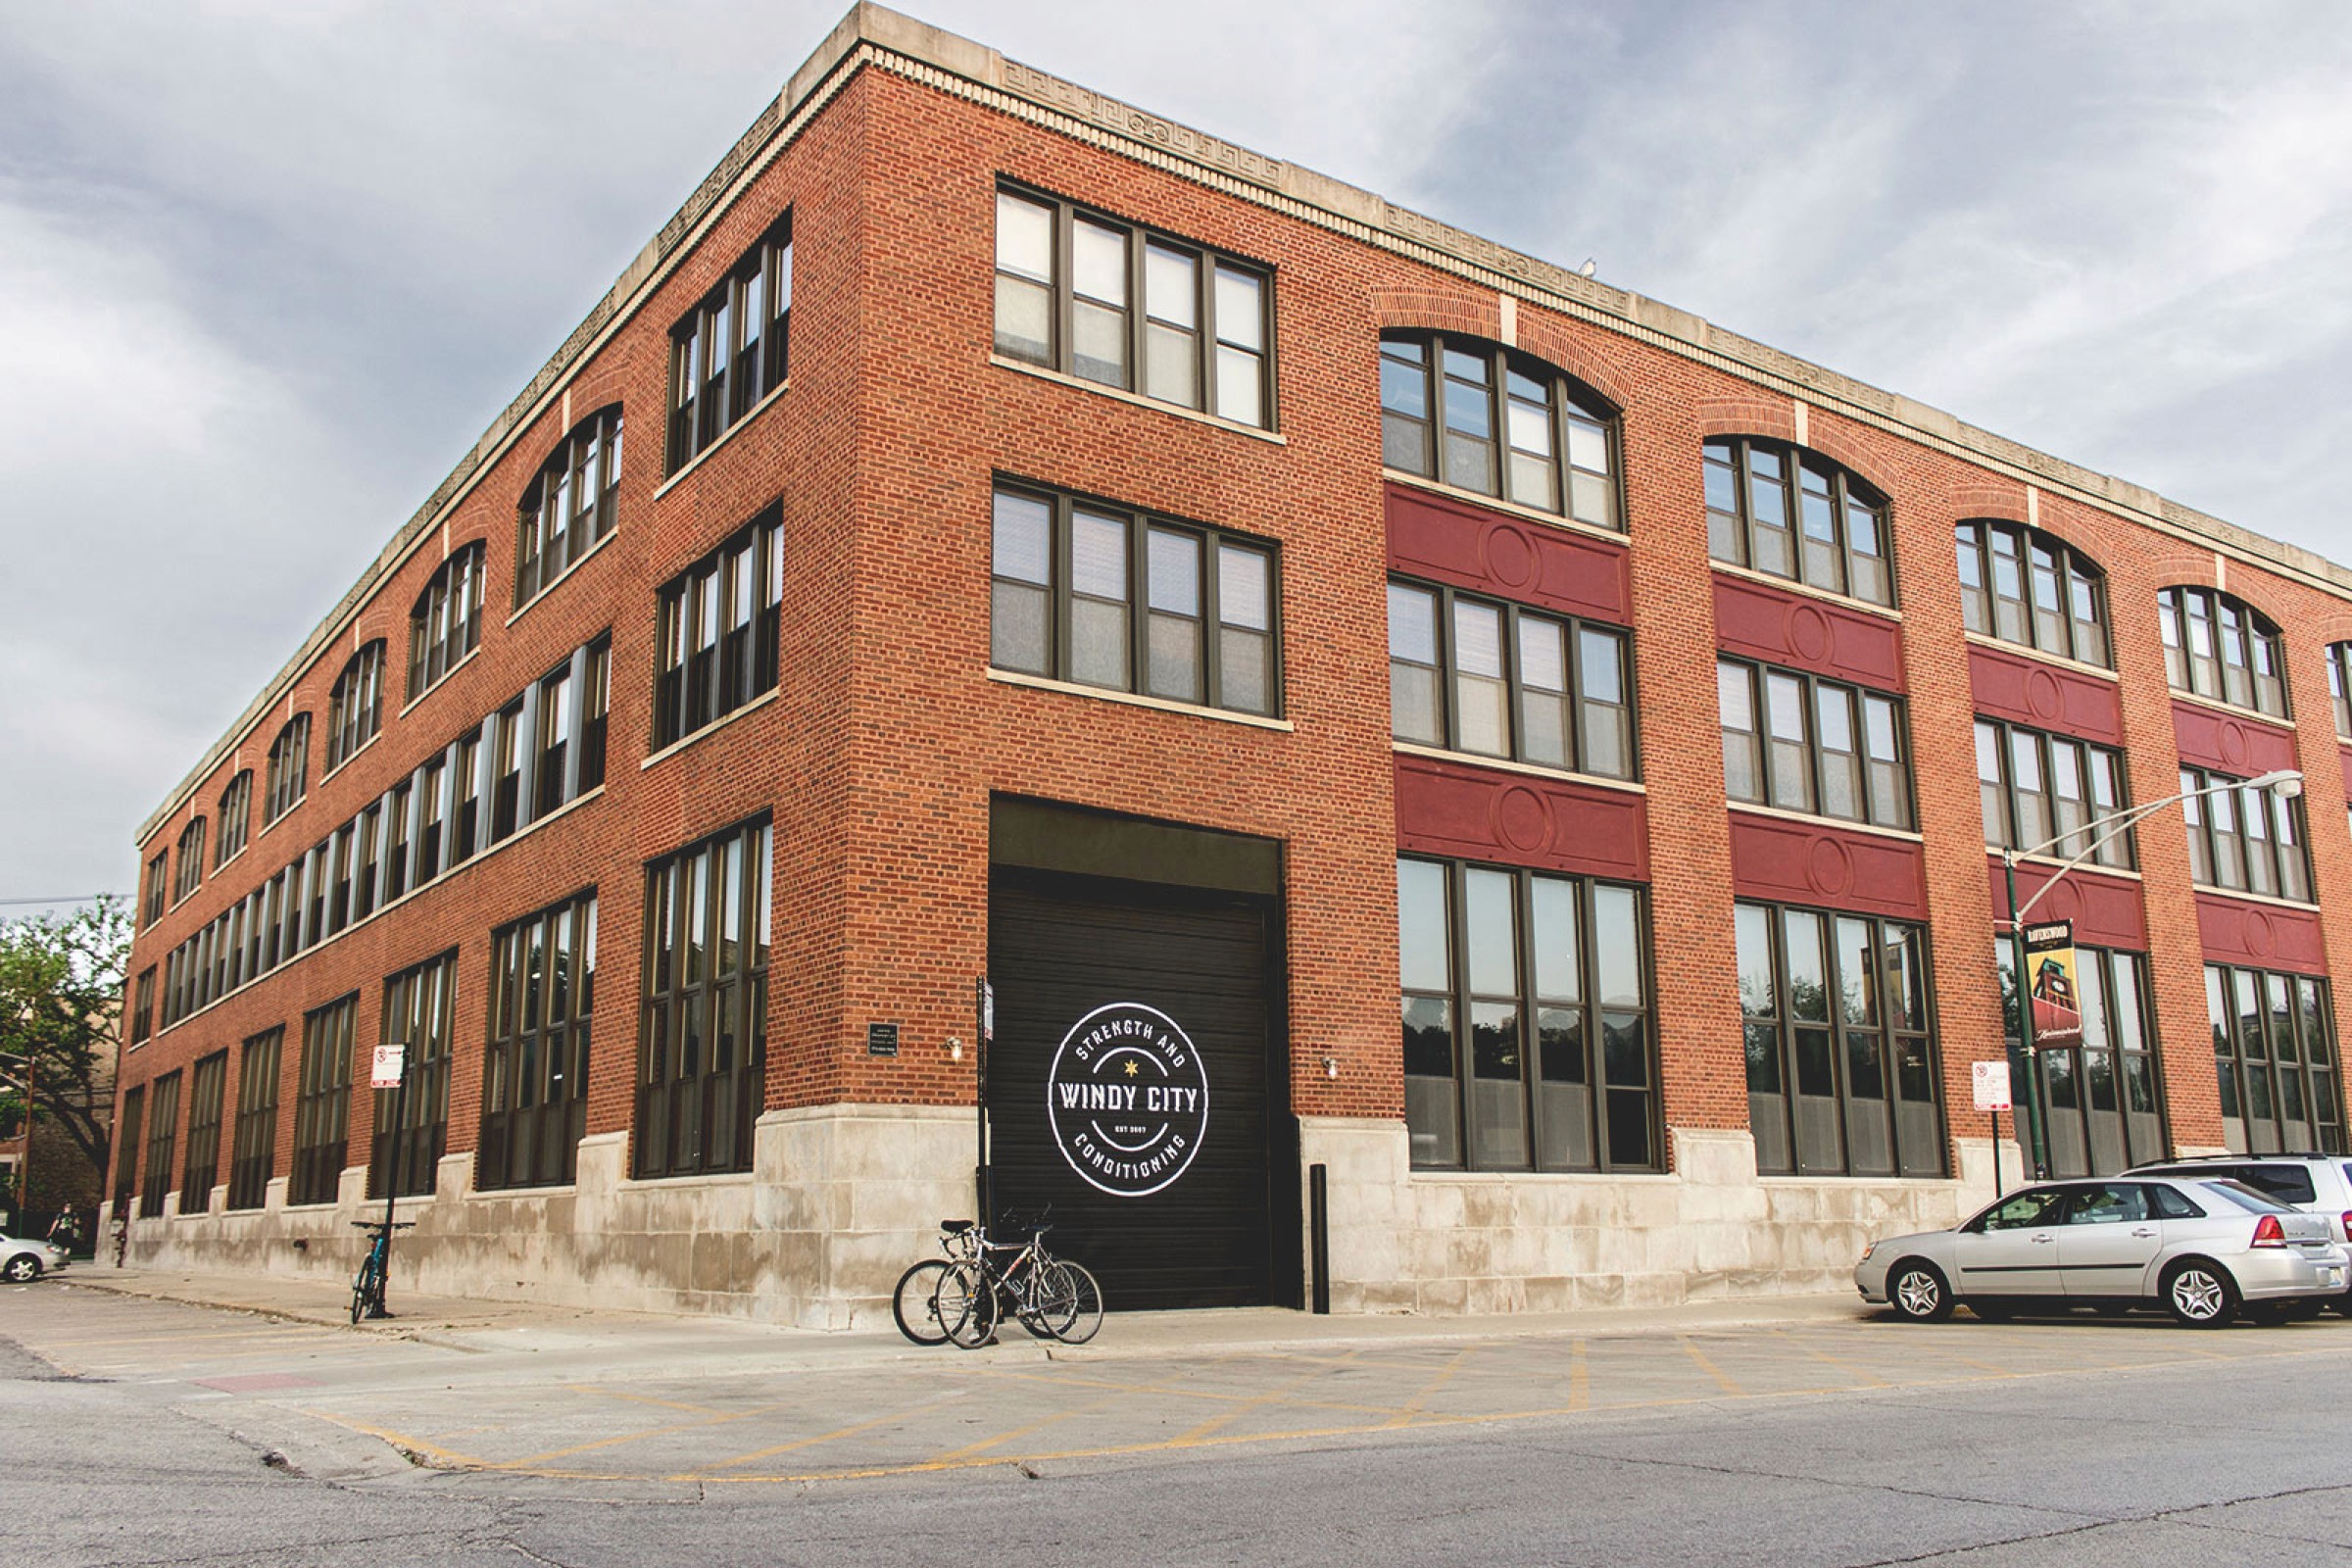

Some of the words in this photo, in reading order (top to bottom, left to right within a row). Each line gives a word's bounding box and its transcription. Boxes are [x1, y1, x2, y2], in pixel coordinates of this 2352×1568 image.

[1075, 1019, 1153, 1060] STRENGTH
[1157, 1034, 1186, 1068] AND
[1057, 1082, 1137, 1111] WINDY
[1147, 1086, 1198, 1113] CITY
[1074, 1132, 1186, 1180] CONDITIONING
